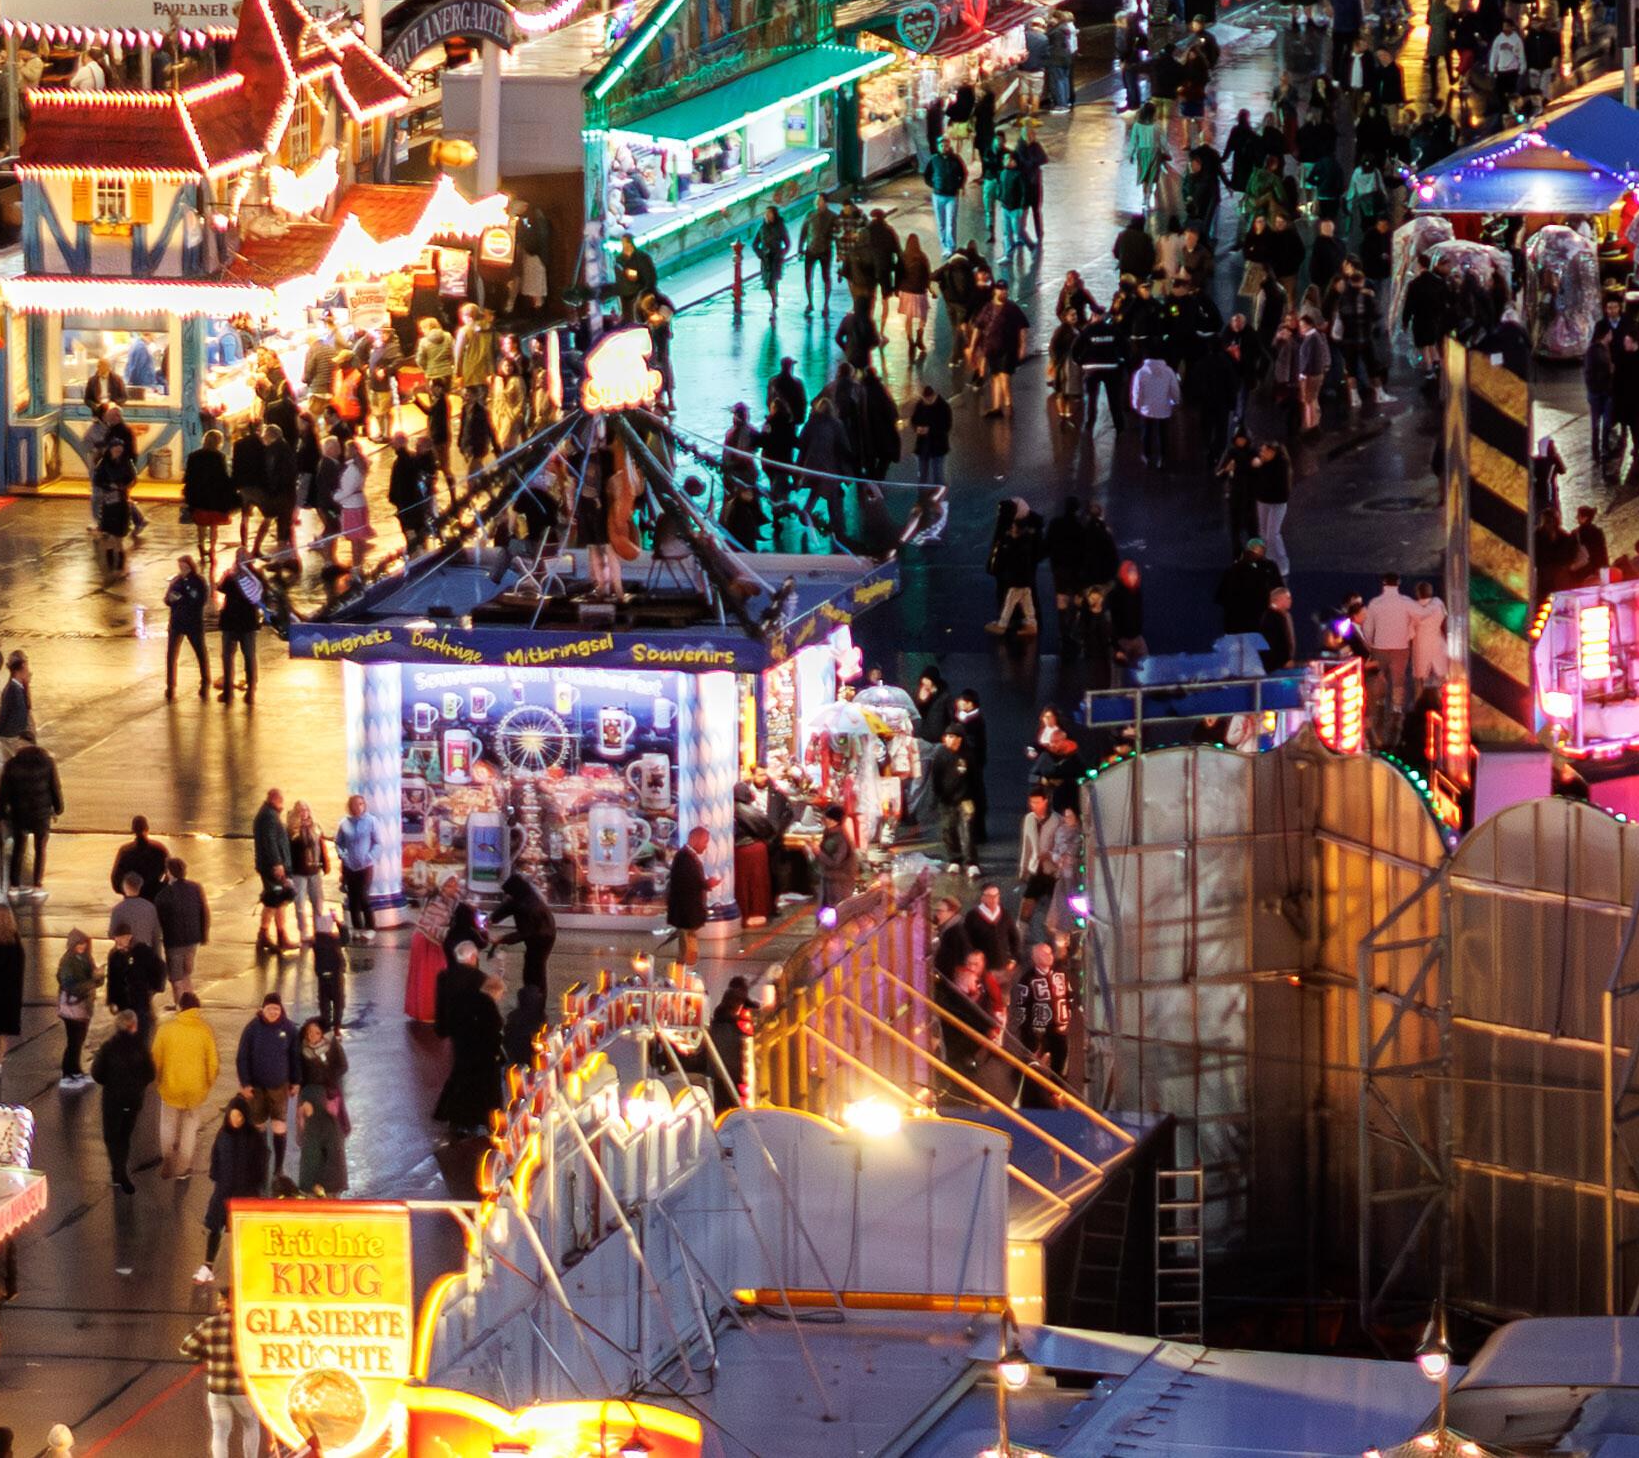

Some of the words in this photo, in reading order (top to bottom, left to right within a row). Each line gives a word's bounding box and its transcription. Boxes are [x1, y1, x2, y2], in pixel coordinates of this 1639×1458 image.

[153, 1, 229, 18] PAULANER
[313, 629, 394, 656] Magnete
[505, 634, 615, 664] Mitbringsel
[632, 641, 736, 664] Souvenirs
[262, 1224, 385, 1259] Früchte
[272, 1263, 383, 1297] KRUG
[246, 1307, 404, 1338] GLASIERTE
[260, 1341, 393, 1371] FRÜCHTE
